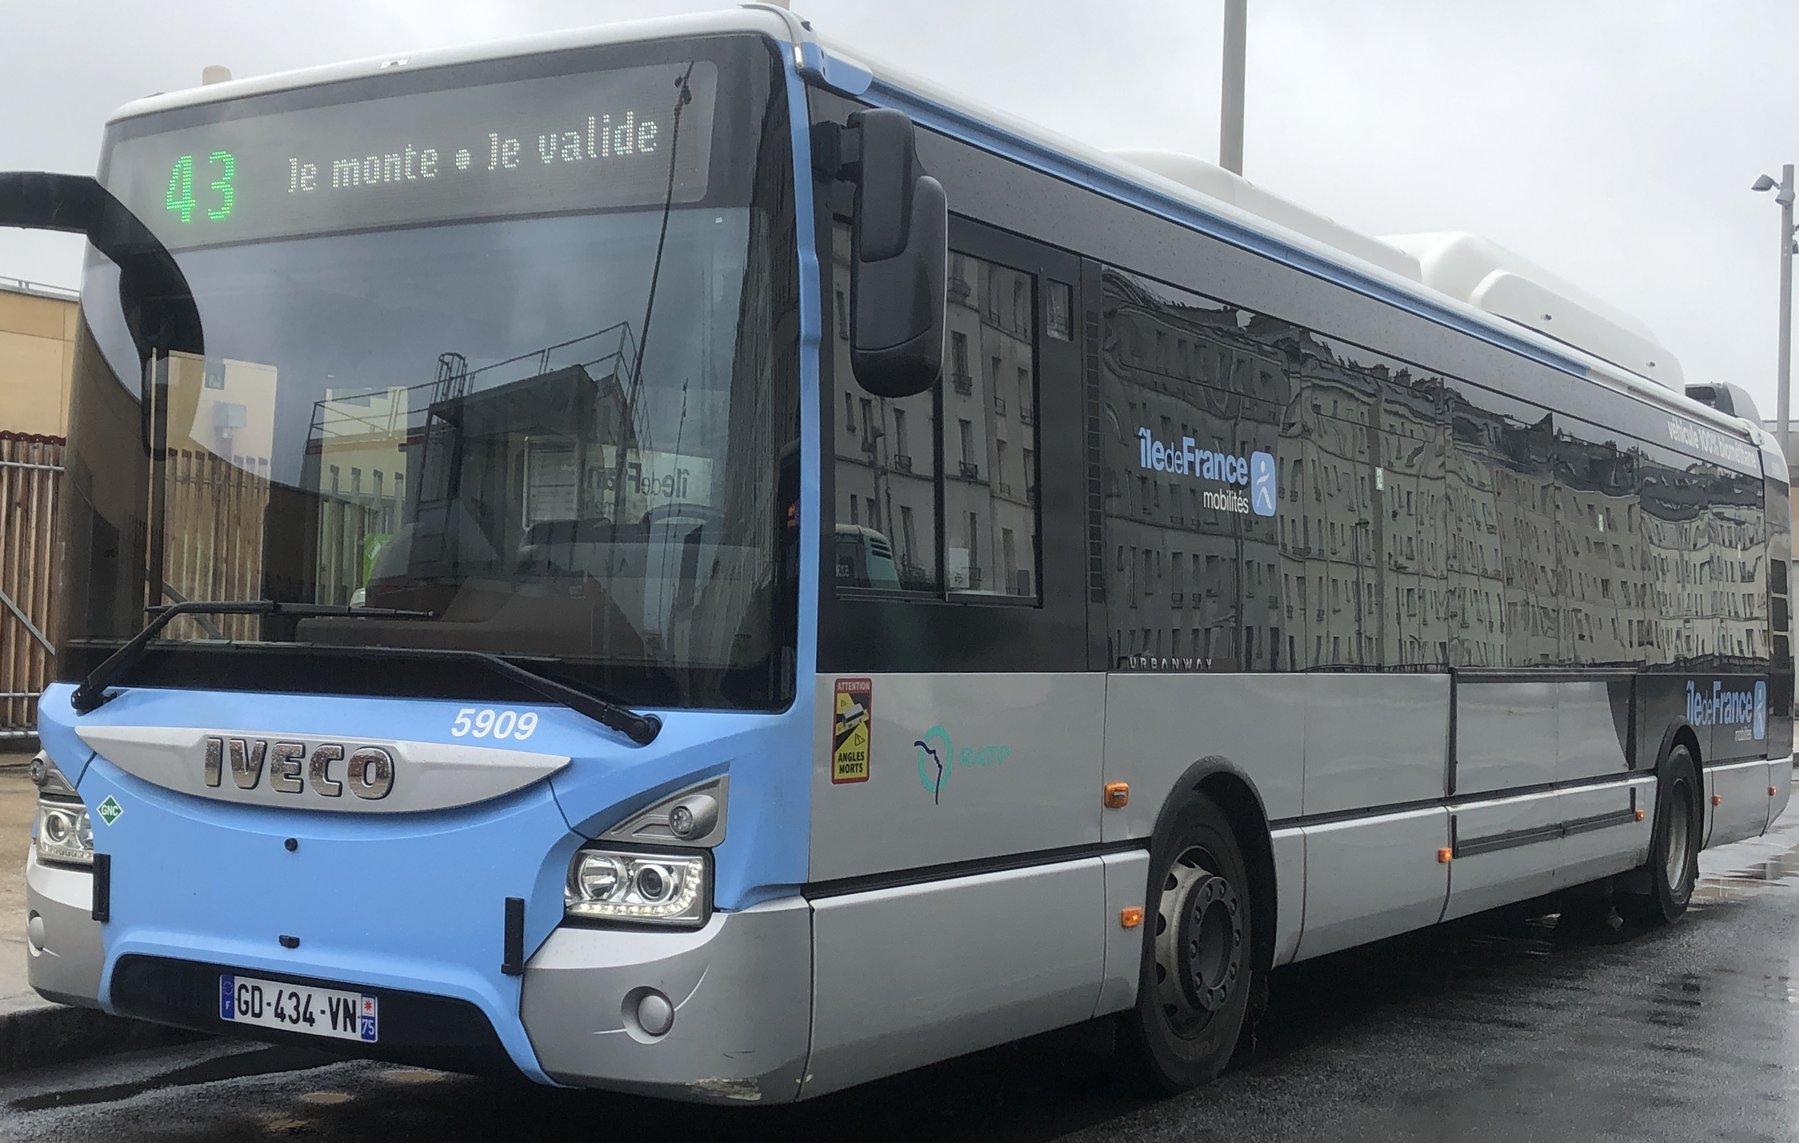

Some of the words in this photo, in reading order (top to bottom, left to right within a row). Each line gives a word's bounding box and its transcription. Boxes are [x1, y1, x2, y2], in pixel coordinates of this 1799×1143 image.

[288, 157, 317, 193] Je
[332, 143, 438, 188] monte
[487, 132, 520, 171] Je
[538, 111, 658, 164] valide
[165, 151, 235, 222] 43
[1203, 488, 1250, 515] mobilités
[1129, 656, 1212, 670] URBANWAY
[837, 681, 871, 692] ATTENTION
[451, 708, 538, 741] 5909
[838, 750, 865, 762] ANGLES
[959, 744, 1011, 769] RATP
[203, 736, 396, 800] IVECO
[838, 762, 863, 774] MORTS
[100, 804, 119, 817] GNC
[224, 1000, 231, 1011] F
[236, 983, 358, 1034] GD-434-VN
[361, 1018, 375, 1036] 75
